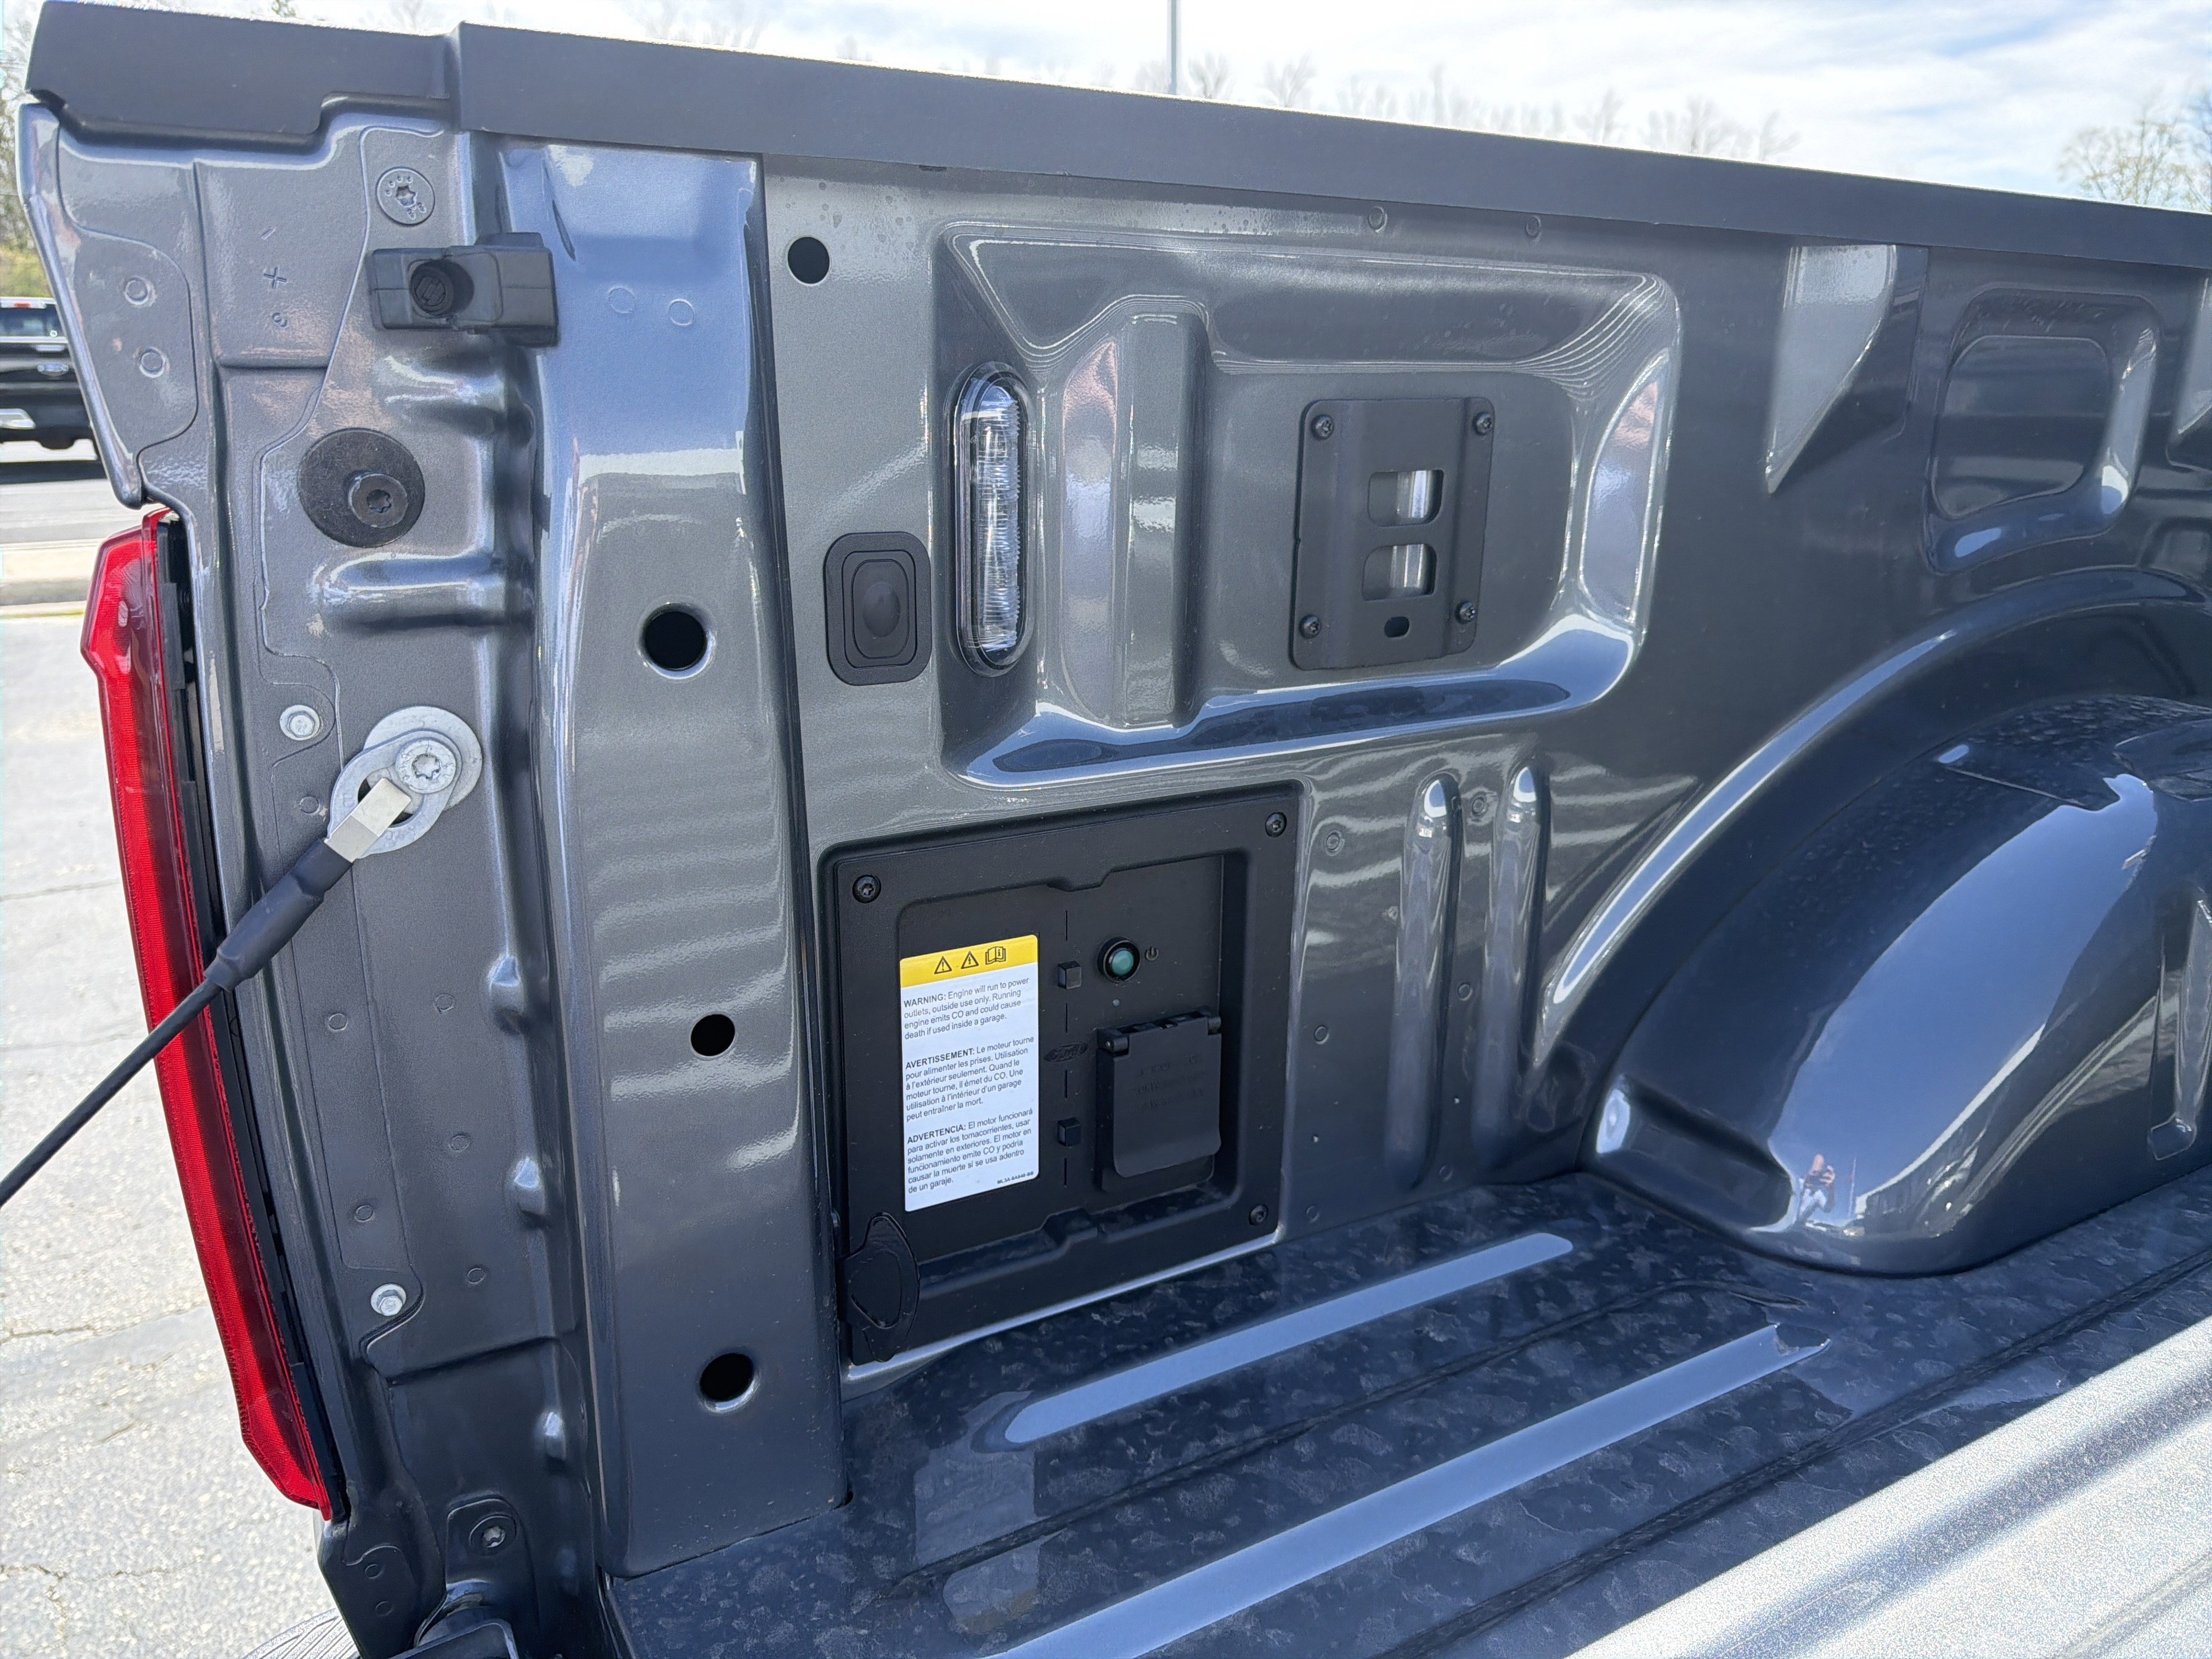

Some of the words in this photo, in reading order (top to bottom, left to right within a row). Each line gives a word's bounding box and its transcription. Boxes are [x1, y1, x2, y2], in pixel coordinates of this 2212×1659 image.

[903, 993, 946, 1008] WARNING:
[947, 989, 972, 999] Engine
[974, 985, 985, 994] will
[1008, 978, 1029, 989] power
[904, 1008, 930, 1018] outlets,
[932, 1002, 958, 1013] outside
[974, 995, 990, 1004] only.
[992, 990, 1020, 1001] Running
[904, 1019, 929, 1029] engine
[930, 1014, 950, 1023] emits
[951, 1010, 963, 1019] CO
[965, 1007, 978, 1017] and
[980, 1003, 998, 1013] could
[1000, 1000, 1021, 1009] cause
[904, 1029, 925, 1040] death
[927, 1026, 932, 1035] if
[932, 1023, 950, 1034] used
[951, 1019, 972, 1029] inside
[980, 1014, 1006, 1025] garage.
[905, 1047, 974, 1070] AVERTISSEMENT:
[987, 1041, 1011, 1051] moteur
[1012, 1036, 1034, 1046] tourne
[905, 1070, 922, 1081] pour
[923, 1063, 956, 1076] alimenter
[969, 1056, 992, 1067] prises.
[995, 1048, 1028, 1060] Utilisation
[948, 1065, 987, 1080] seulement.
[989, 1059, 1012, 1071] Quand
[906, 1089, 931, 1101] moteur
[932, 1084, 957, 1094] tourne,
[994, 1071, 1007, 1080] CO.
[906, 1097, 939, 1110] utilisation
[981, 1085, 996, 1093] d'un
[997, 1080, 1021, 1091] garage
[906, 1110, 922, 1122] peut
[923, 1104, 956, 1116] entraîner
[965, 1097, 983, 1107] mort.
[907, 1124, 966, 1144] ADVERTENCIA:
[968, 1121, 975, 1129] El
[977, 1117, 996, 1127] motor
[907, 1145, 923, 1155] para
[925, 1138, 948, 1149] activar
[1015, 1119, 1030, 1127] usar
[907, 1149, 944, 1164] solamente
[956, 1138, 991, 1152] exteriores.
[994, 1134, 1000, 1142] El
[1002, 1130, 1021, 1141] motor
[907, 1155, 961, 1173] funcionamiento
[962, 1150, 981, 1160] emite
[983, 1146, 995, 1154] CO
[908, 1172, 932, 1183] causar
[941, 1164, 966, 1175] muerte
[999, 1149, 1024, 1160] adentro
[929, 1176, 953, 1189] garaje.
